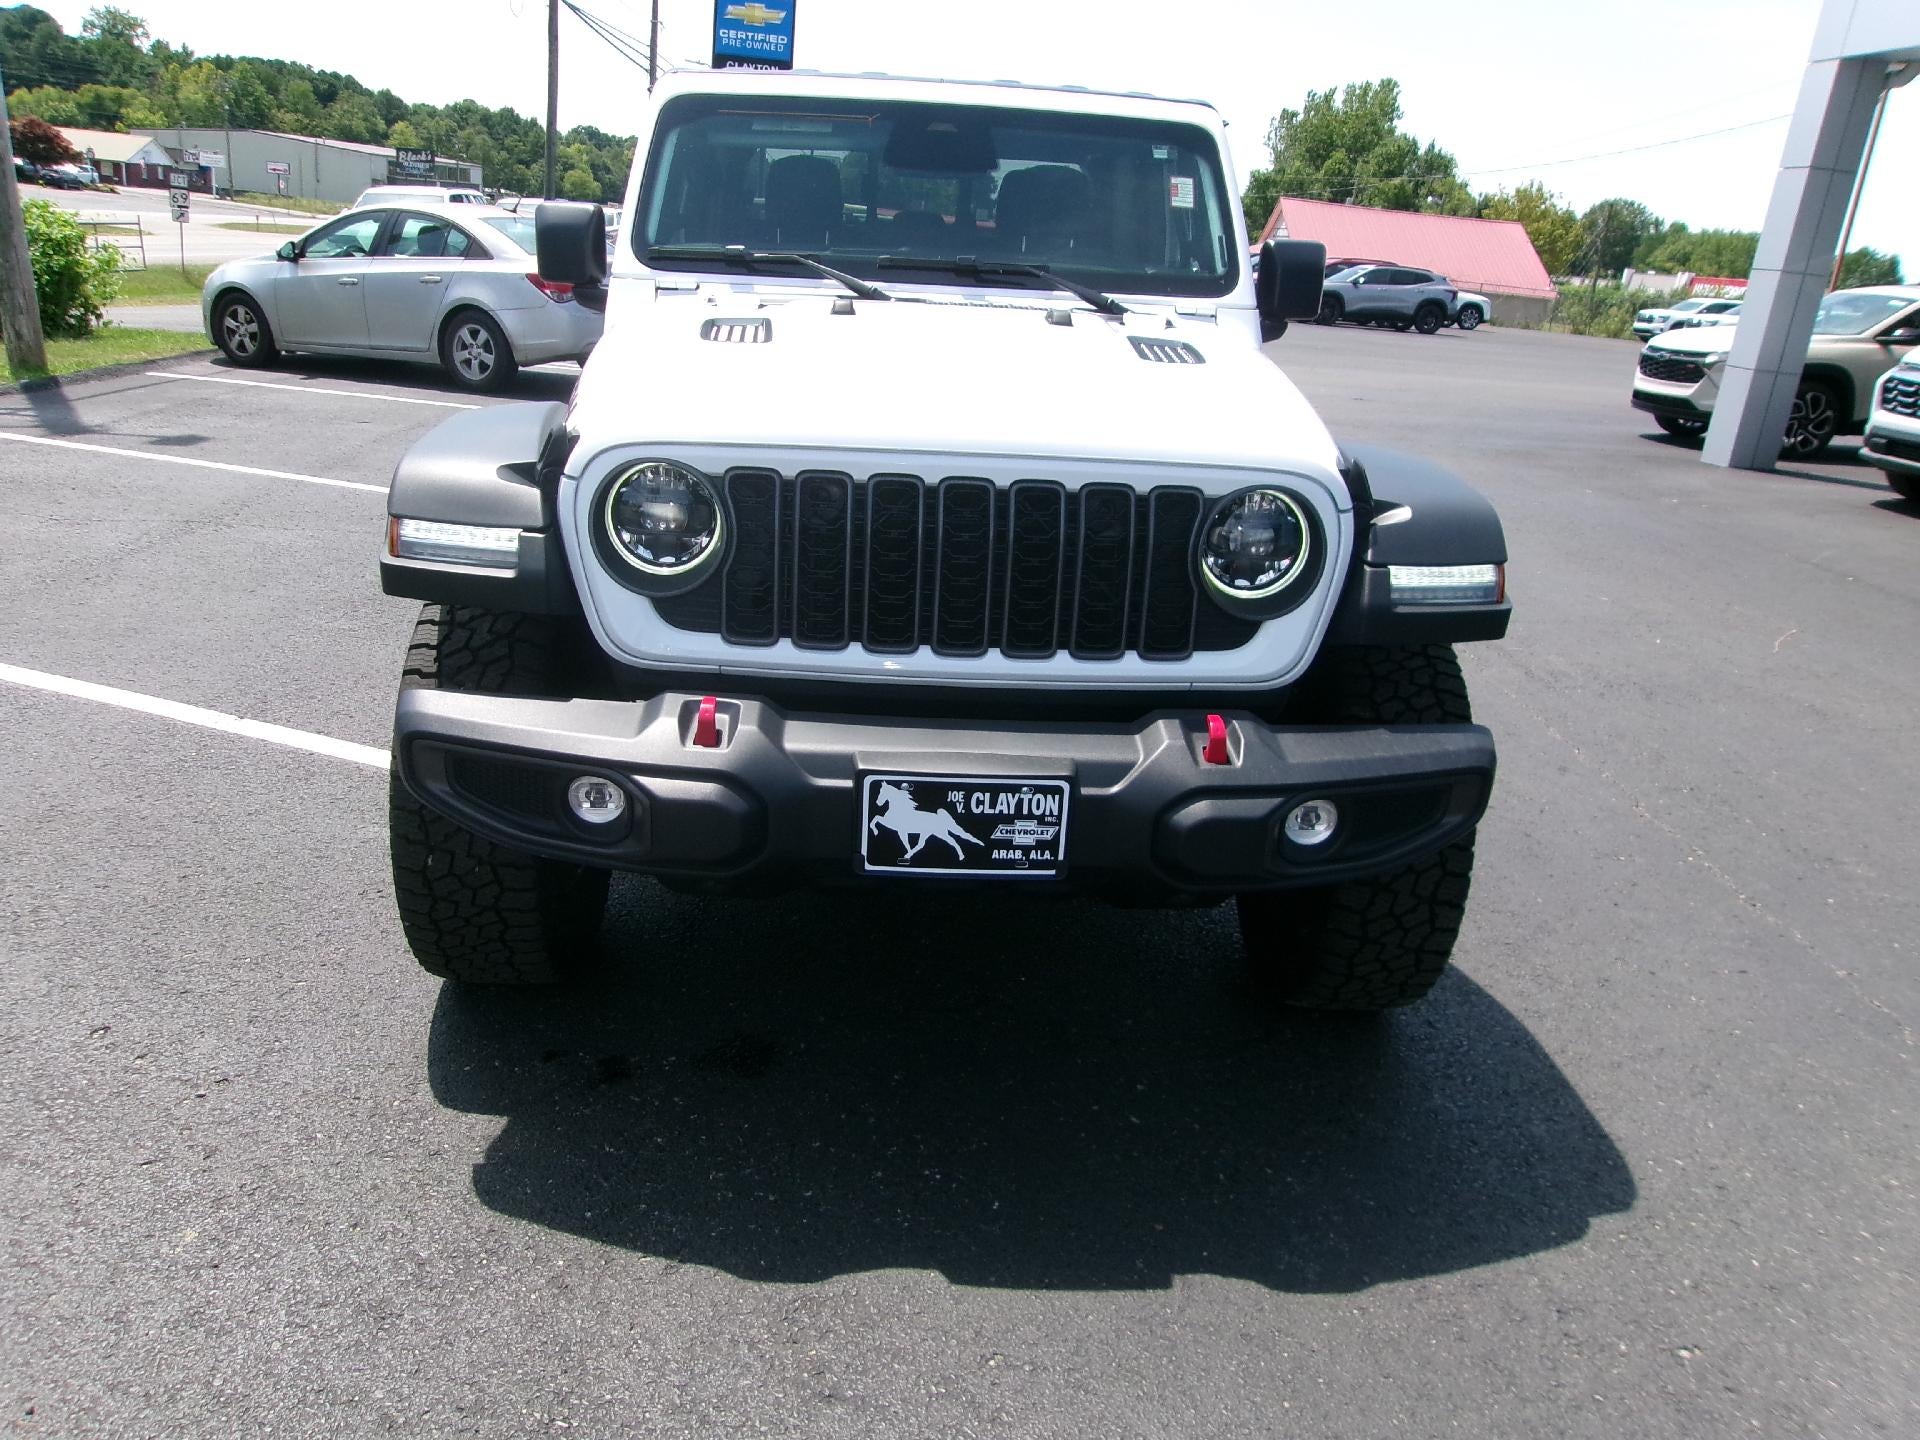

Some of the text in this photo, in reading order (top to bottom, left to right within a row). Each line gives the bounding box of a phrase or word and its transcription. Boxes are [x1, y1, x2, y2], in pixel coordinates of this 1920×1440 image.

[719, 29, 788, 44] CERTIFIED
[722, 39, 784, 51] PRE-OWNED
[171, 175, 187, 185] JCT
[172, 192, 188, 204] 69
[947, 790, 1059, 815] JOE CLAYTON
[956, 802, 965, 814] V.
[999, 827, 1051, 837] CHEVROLET
[992, 849, 1054, 861] ARAB, ALA.
